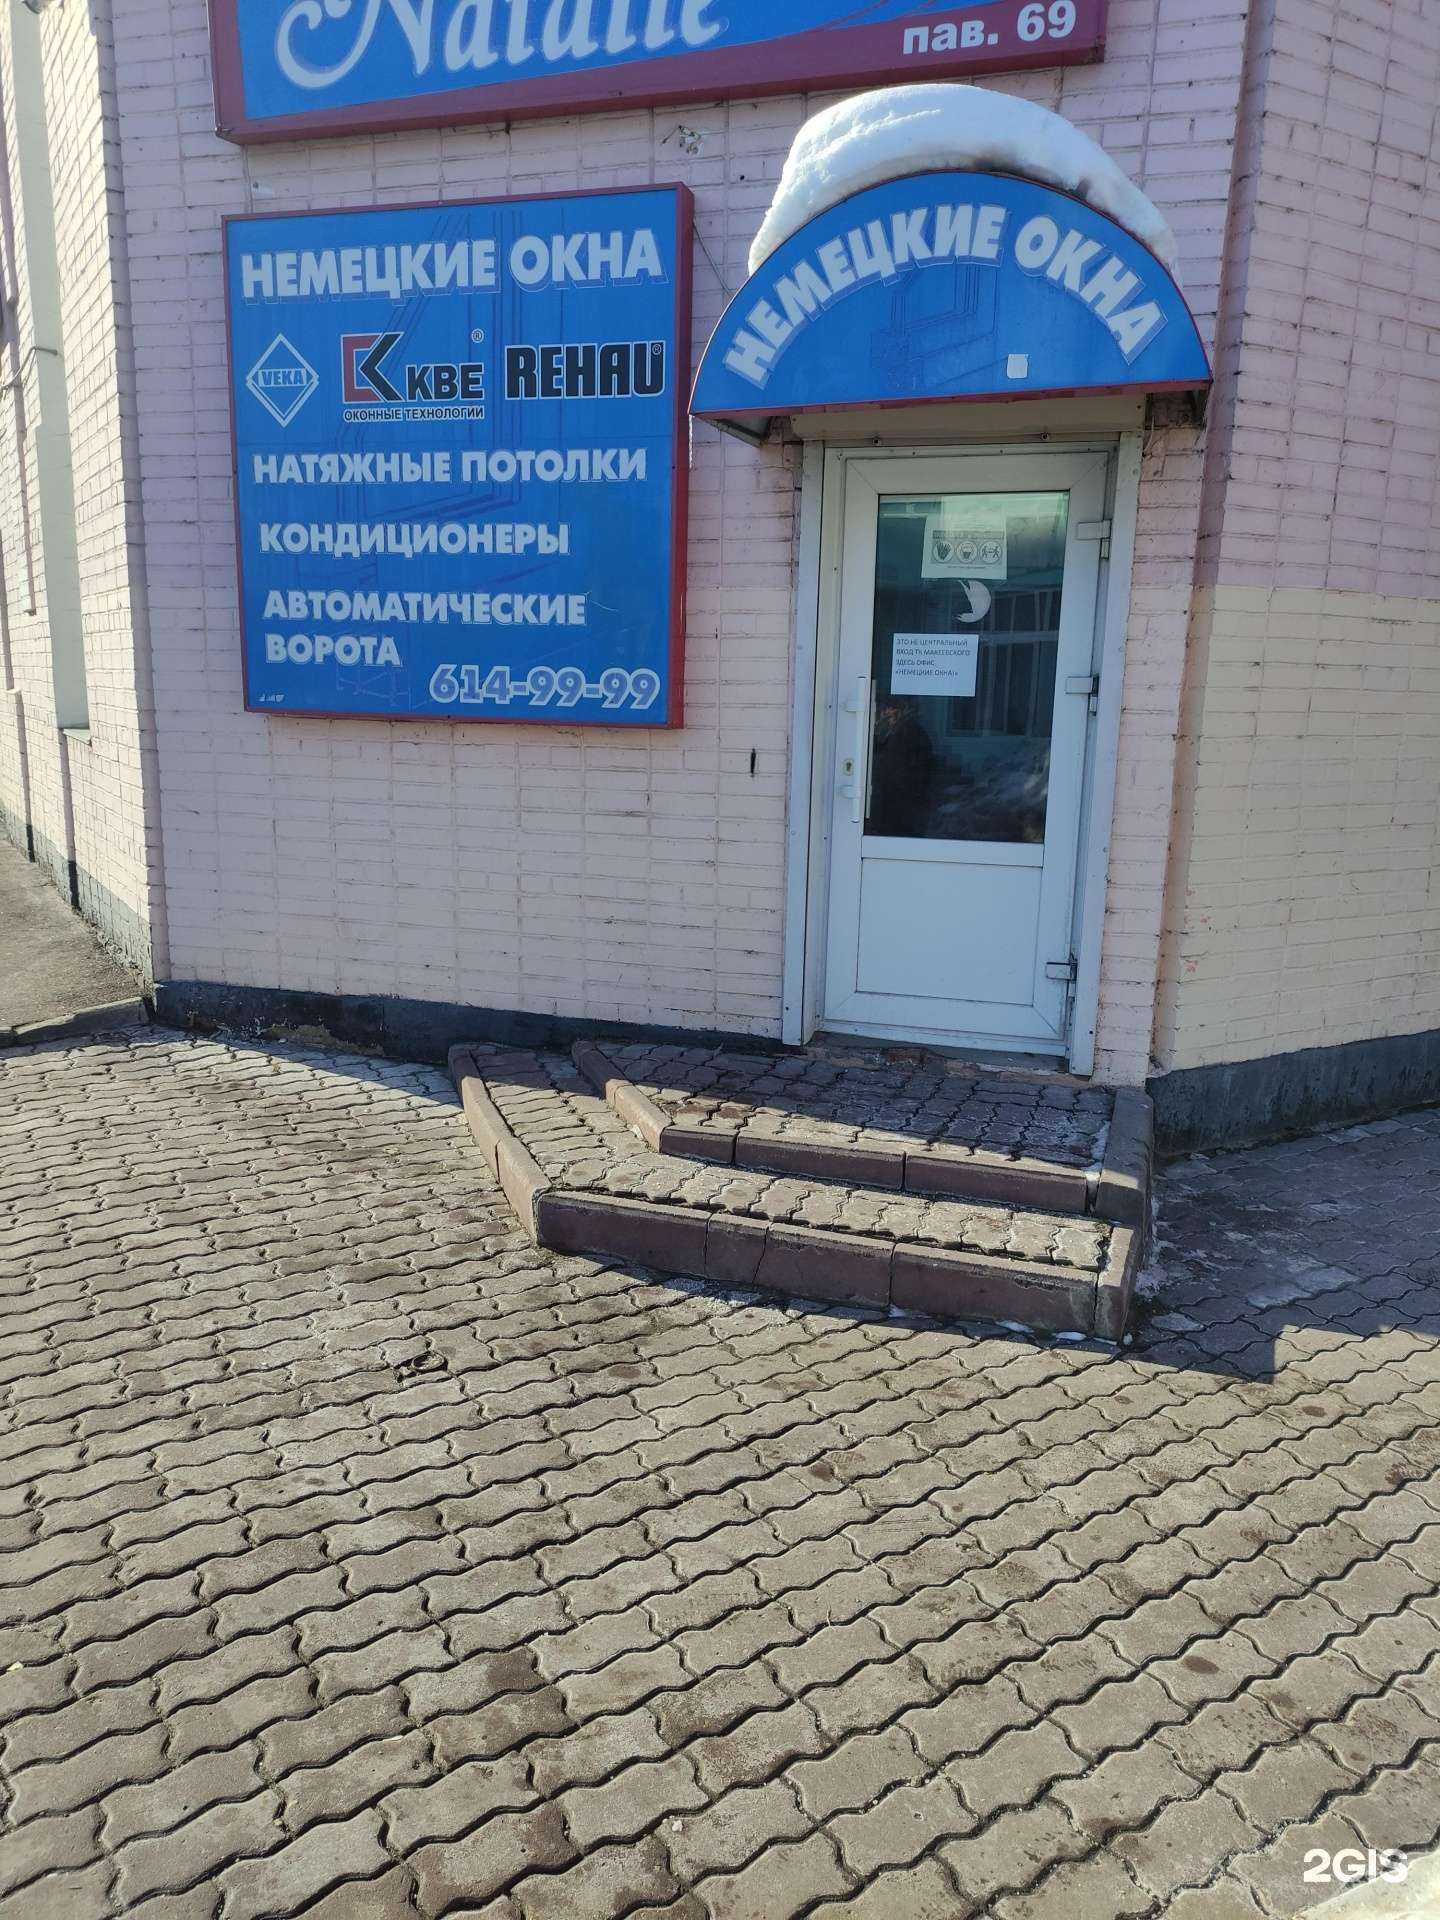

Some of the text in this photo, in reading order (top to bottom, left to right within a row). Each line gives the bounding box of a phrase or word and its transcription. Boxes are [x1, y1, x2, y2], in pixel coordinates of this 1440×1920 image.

[903, 0, 1076, 54] пав. 69
[241, 228, 665, 303] НЕМЕЦКИЕ ОКНА
[721, 204, 1164, 385] НЕМЕЦКИЕ ОКНА
[258, 368, 306, 386] VEKA
[405, 362, 485, 402] KBE
[505, 341, 666, 400] REHAU
[343, 405, 485, 423] ОКОННЫЕ ТЕХНОЛОГИИ
[253, 448, 648, 484] НАТЯЖНЫЕ ПОТОЛКИ
[259, 523, 571, 558] КОНДИЦИОНЕРЫ
[262, 590, 588, 626] АВТОМАТИЧЕСКИЕ
[264, 634, 403, 667] ВОРОТА
[429, 664, 662, 710] 614-99-99
